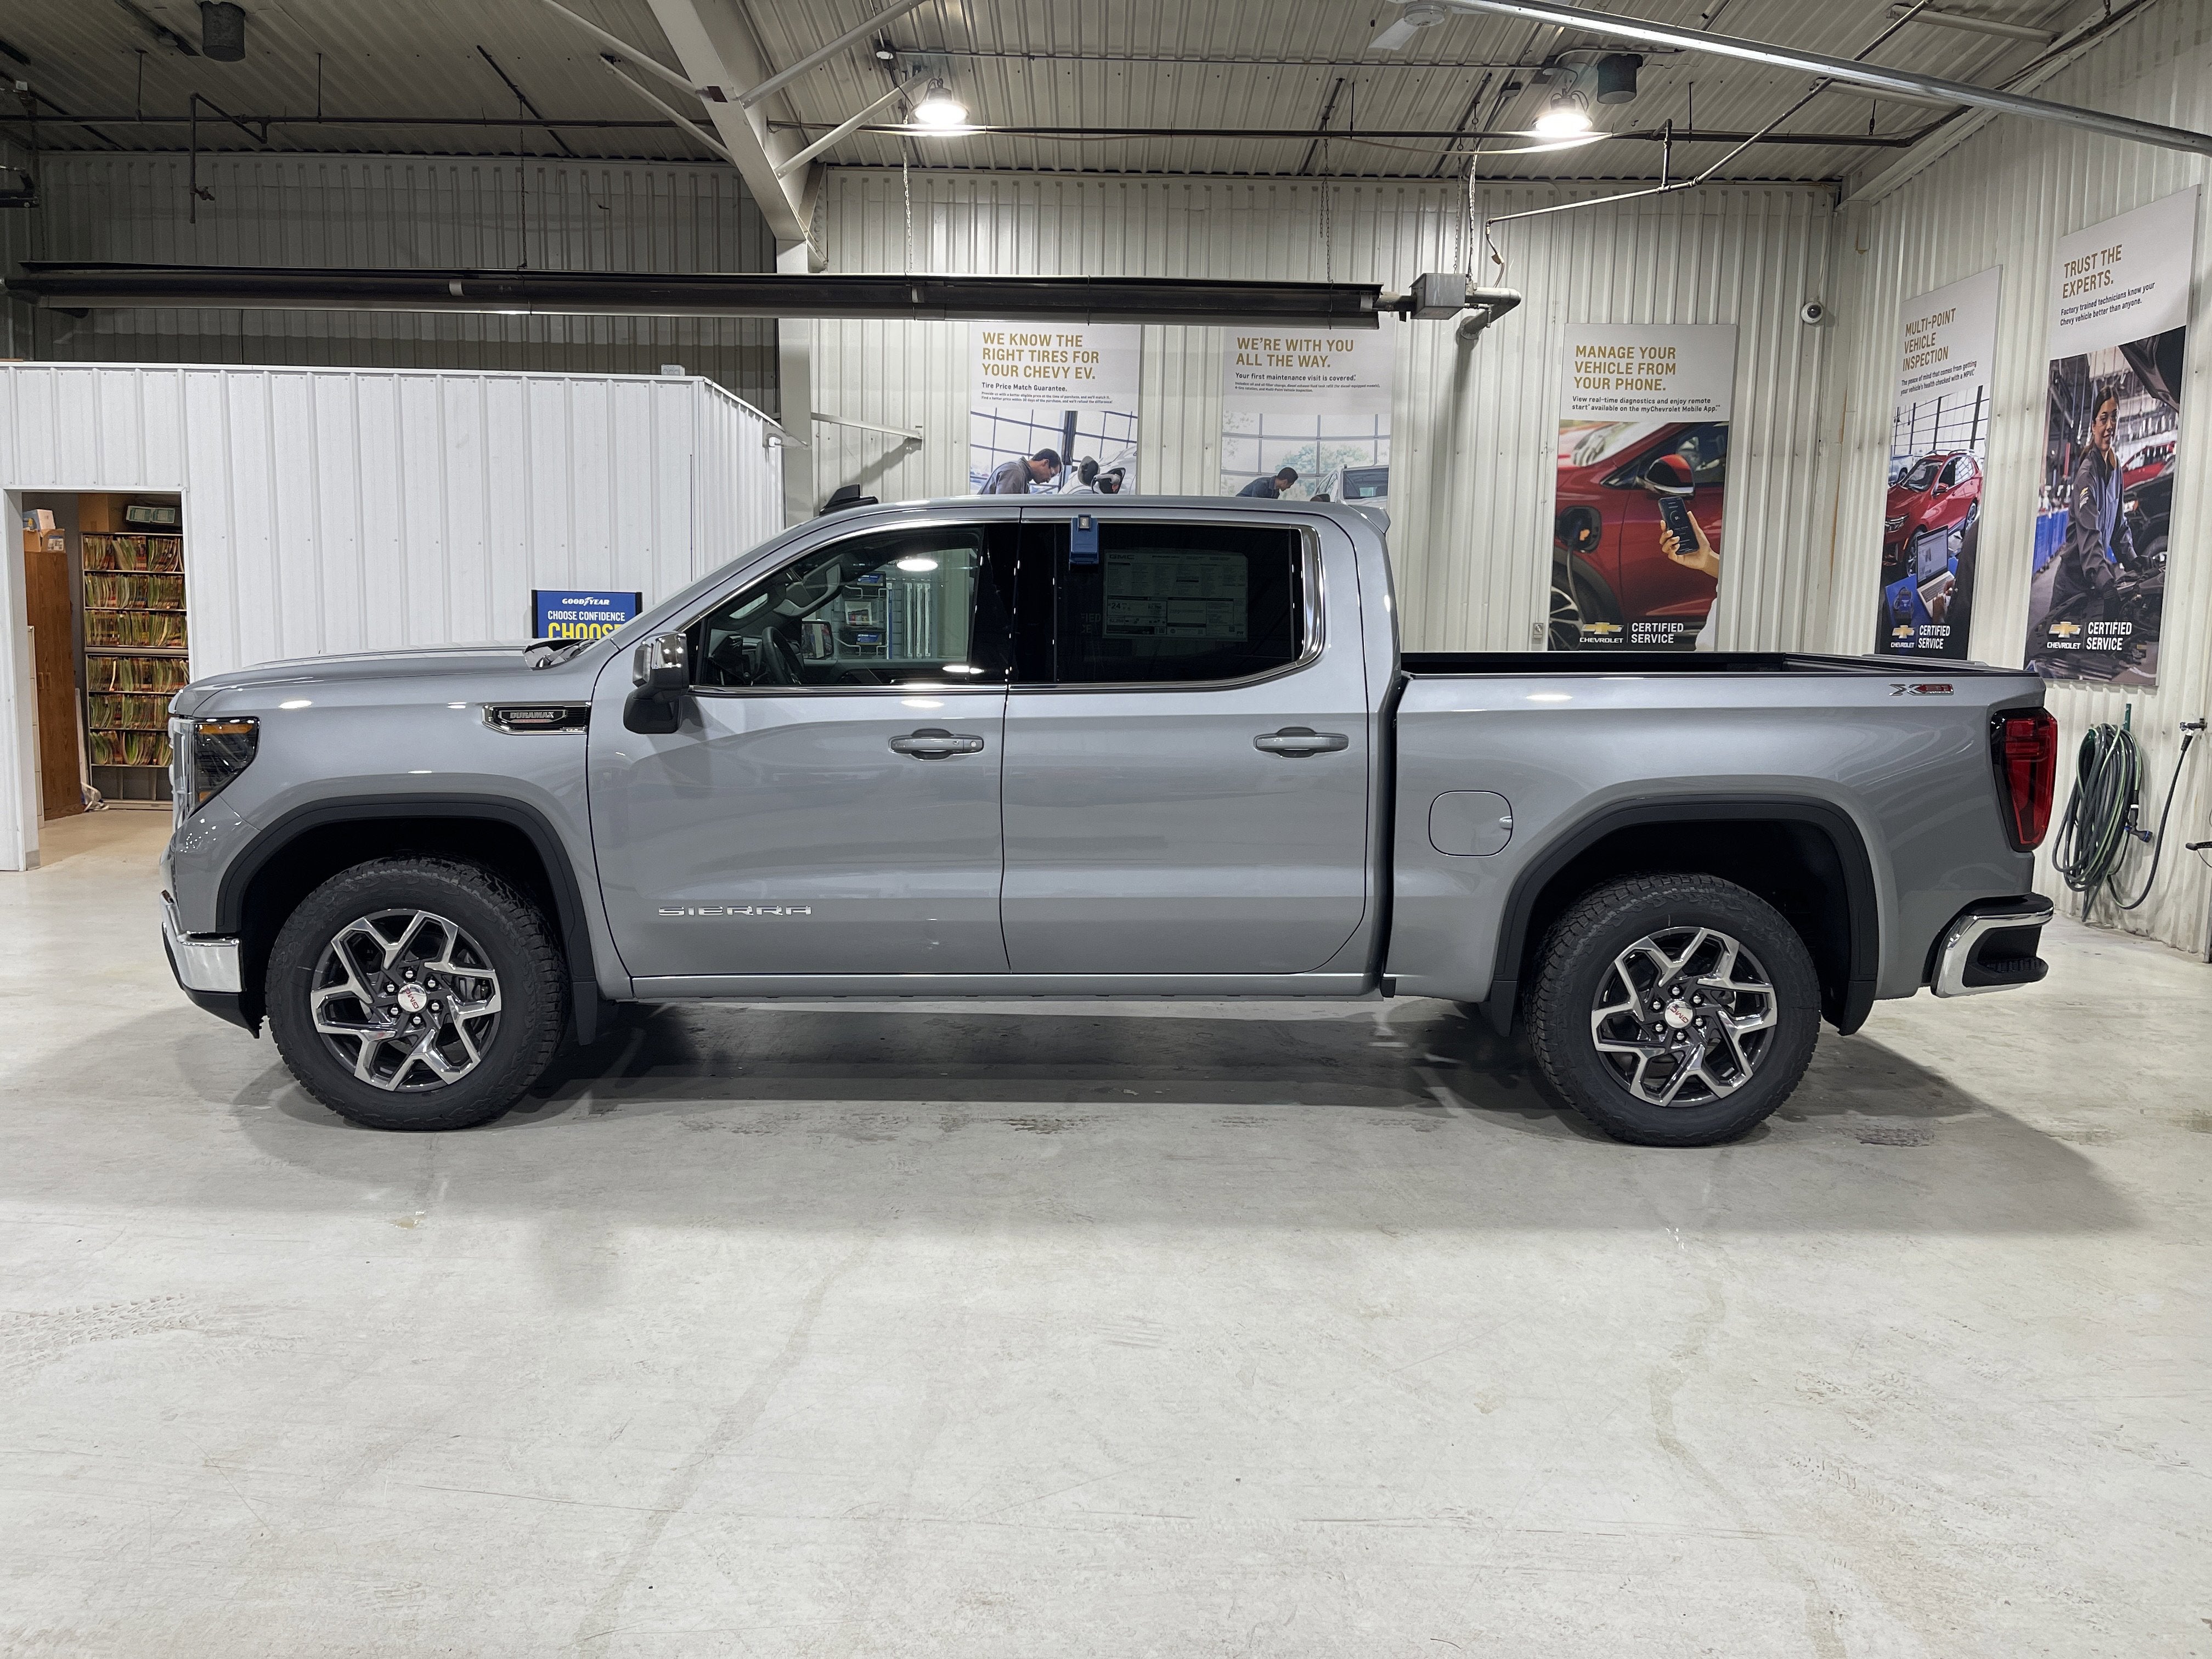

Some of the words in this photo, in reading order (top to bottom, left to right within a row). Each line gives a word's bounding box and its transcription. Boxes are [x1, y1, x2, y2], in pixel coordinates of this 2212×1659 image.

[2064, 253, 2098, 278] TRUST
[2101, 244, 2122, 266] THE
[2062, 269, 2113, 299] EXPERTS.
[2061, 307, 2079, 315] Factory
[2080, 299, 2097, 311] trained
[2098, 292, 2126, 306] technicians
[2128, 286, 2142, 297] know
[2142, 283, 2155, 294] your
[2061, 318, 2074, 326] Chevy
[2075, 312, 2092, 322] vehicle
[2093, 308, 2108, 318] better
[2109, 303, 2121, 313] than
[2121, 298, 2142, 309] anyone.
[1905, 308, 1956, 337] MULTI-POINT
[983, 332, 1005, 345] WE
[1009, 333, 1052, 346] KNOW
[1056, 335, 1082, 347] THE
[1237, 337, 1281, 351] WE'RE
[1285, 338, 1322, 352] WITH
[1327, 339, 1354, 352] YOU
[1904, 332, 1936, 354] VEHICLE
[983, 347, 1024, 362] RIGHT
[1028, 349, 1068, 363] TIRES
[1073, 351, 1099, 363] FOR
[1576, 345, 1635, 359] MANAGE
[1639, 347, 1676, 359] YOUR
[1903, 346, 1949, 371] INSPECTION
[1236, 353, 1262, 366] ALL
[1267, 354, 1294, 367] THE
[1298, 355, 1331, 368] WAY.
[1575, 361, 1633, 375] VEHICLE
[1638, 363, 1676, 375] FROM
[982, 363, 1019, 377] YOUR
[1024, 365, 1070, 379] CHEVY
[1075, 367, 1096, 379] EV.
[1574, 376, 1610, 390] YOUR
[1615, 378, 1666, 391] PHONE.
[1620, 397, 1655, 405] diagnostics
[562, 597, 610, 606] GOODYEAR
[548, 611, 577, 620] CHOOSE
[579, 612, 625, 621] CONFIDENCE
[548, 622, 622, 639] CHOOS
[1632, 623, 1684, 633] CERTIFIED
[1920, 625, 1950, 636] CERTIFIED
[2088, 622, 2132, 635] CERTIFIED
[1631, 634, 1674, 644] SERVICE
[1918, 638, 1944, 649] SERVICE
[2086, 637, 2123, 651] SERVICE
[658, 906, 812, 916] SIERRA
[404, 988, 419, 1009] GMC
[1669, 1003, 1689, 1024] GMC
